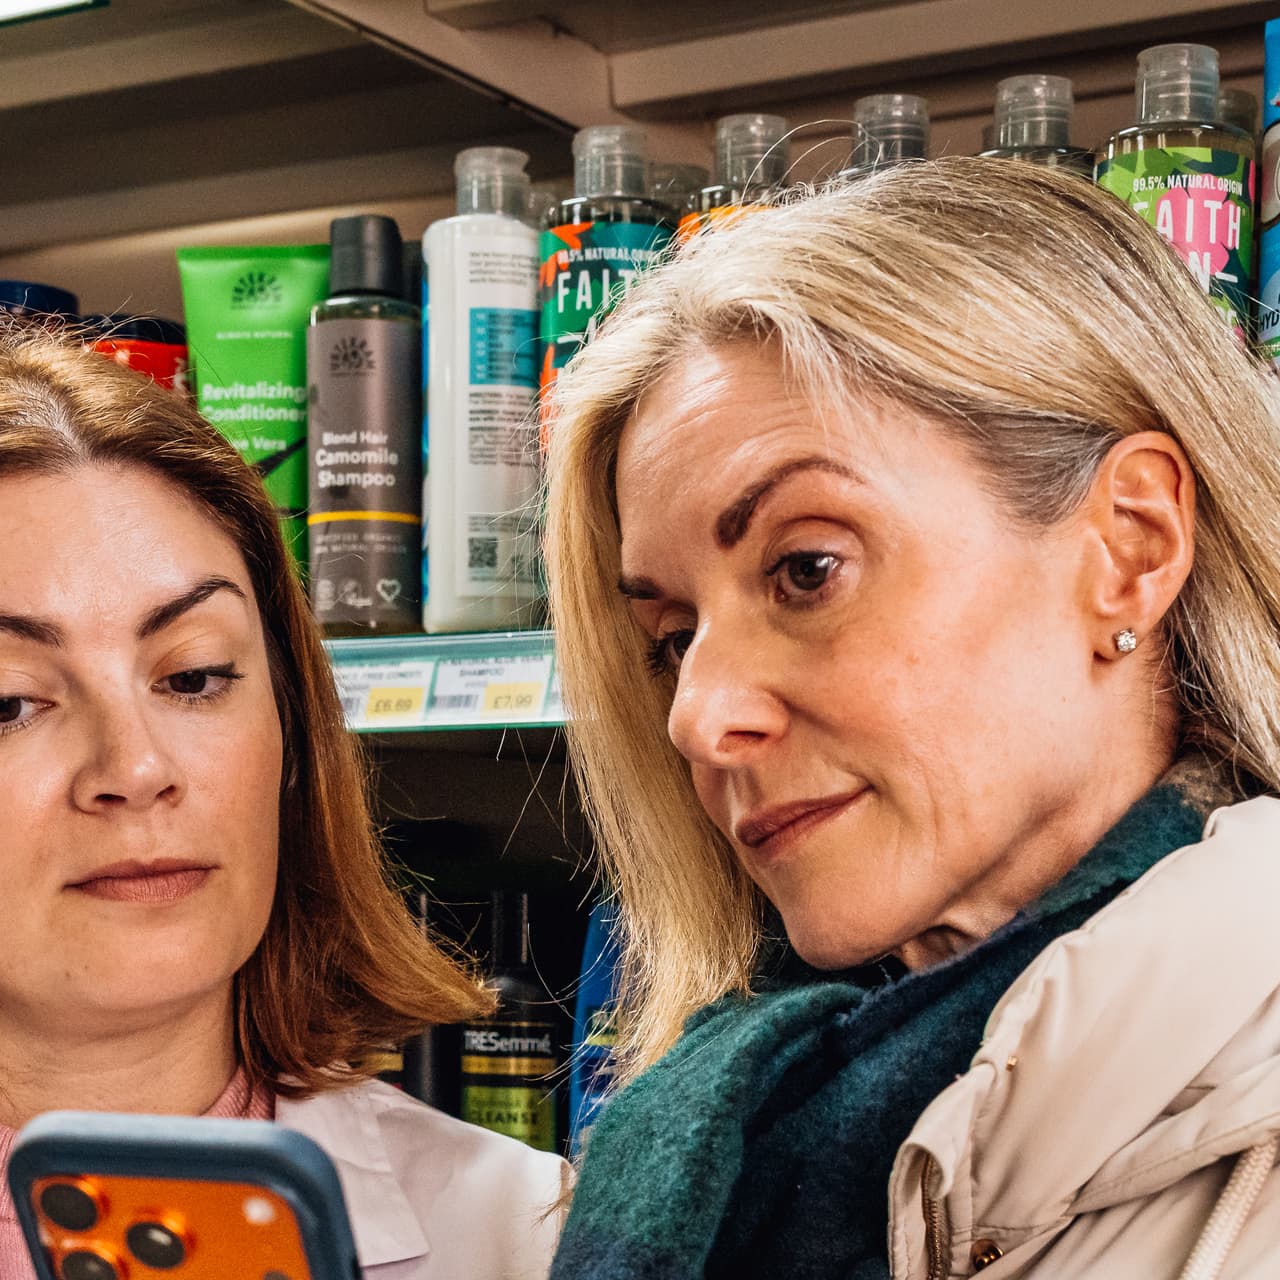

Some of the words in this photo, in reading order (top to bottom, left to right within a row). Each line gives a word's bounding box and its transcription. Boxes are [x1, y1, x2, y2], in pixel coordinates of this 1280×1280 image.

[1133, 176, 1166, 193] 99.5%
[1167, 174, 1216, 190] NATURAL
[1218, 177, 1243, 196] ORIGIN
[201, 383, 308, 403] Revitalizing
[359, 431, 388, 444] Hair
[315, 449, 399, 467] Camomile
[317, 470, 396, 488] Shampoo
[464, 1029, 551, 1052] TRESemmé
